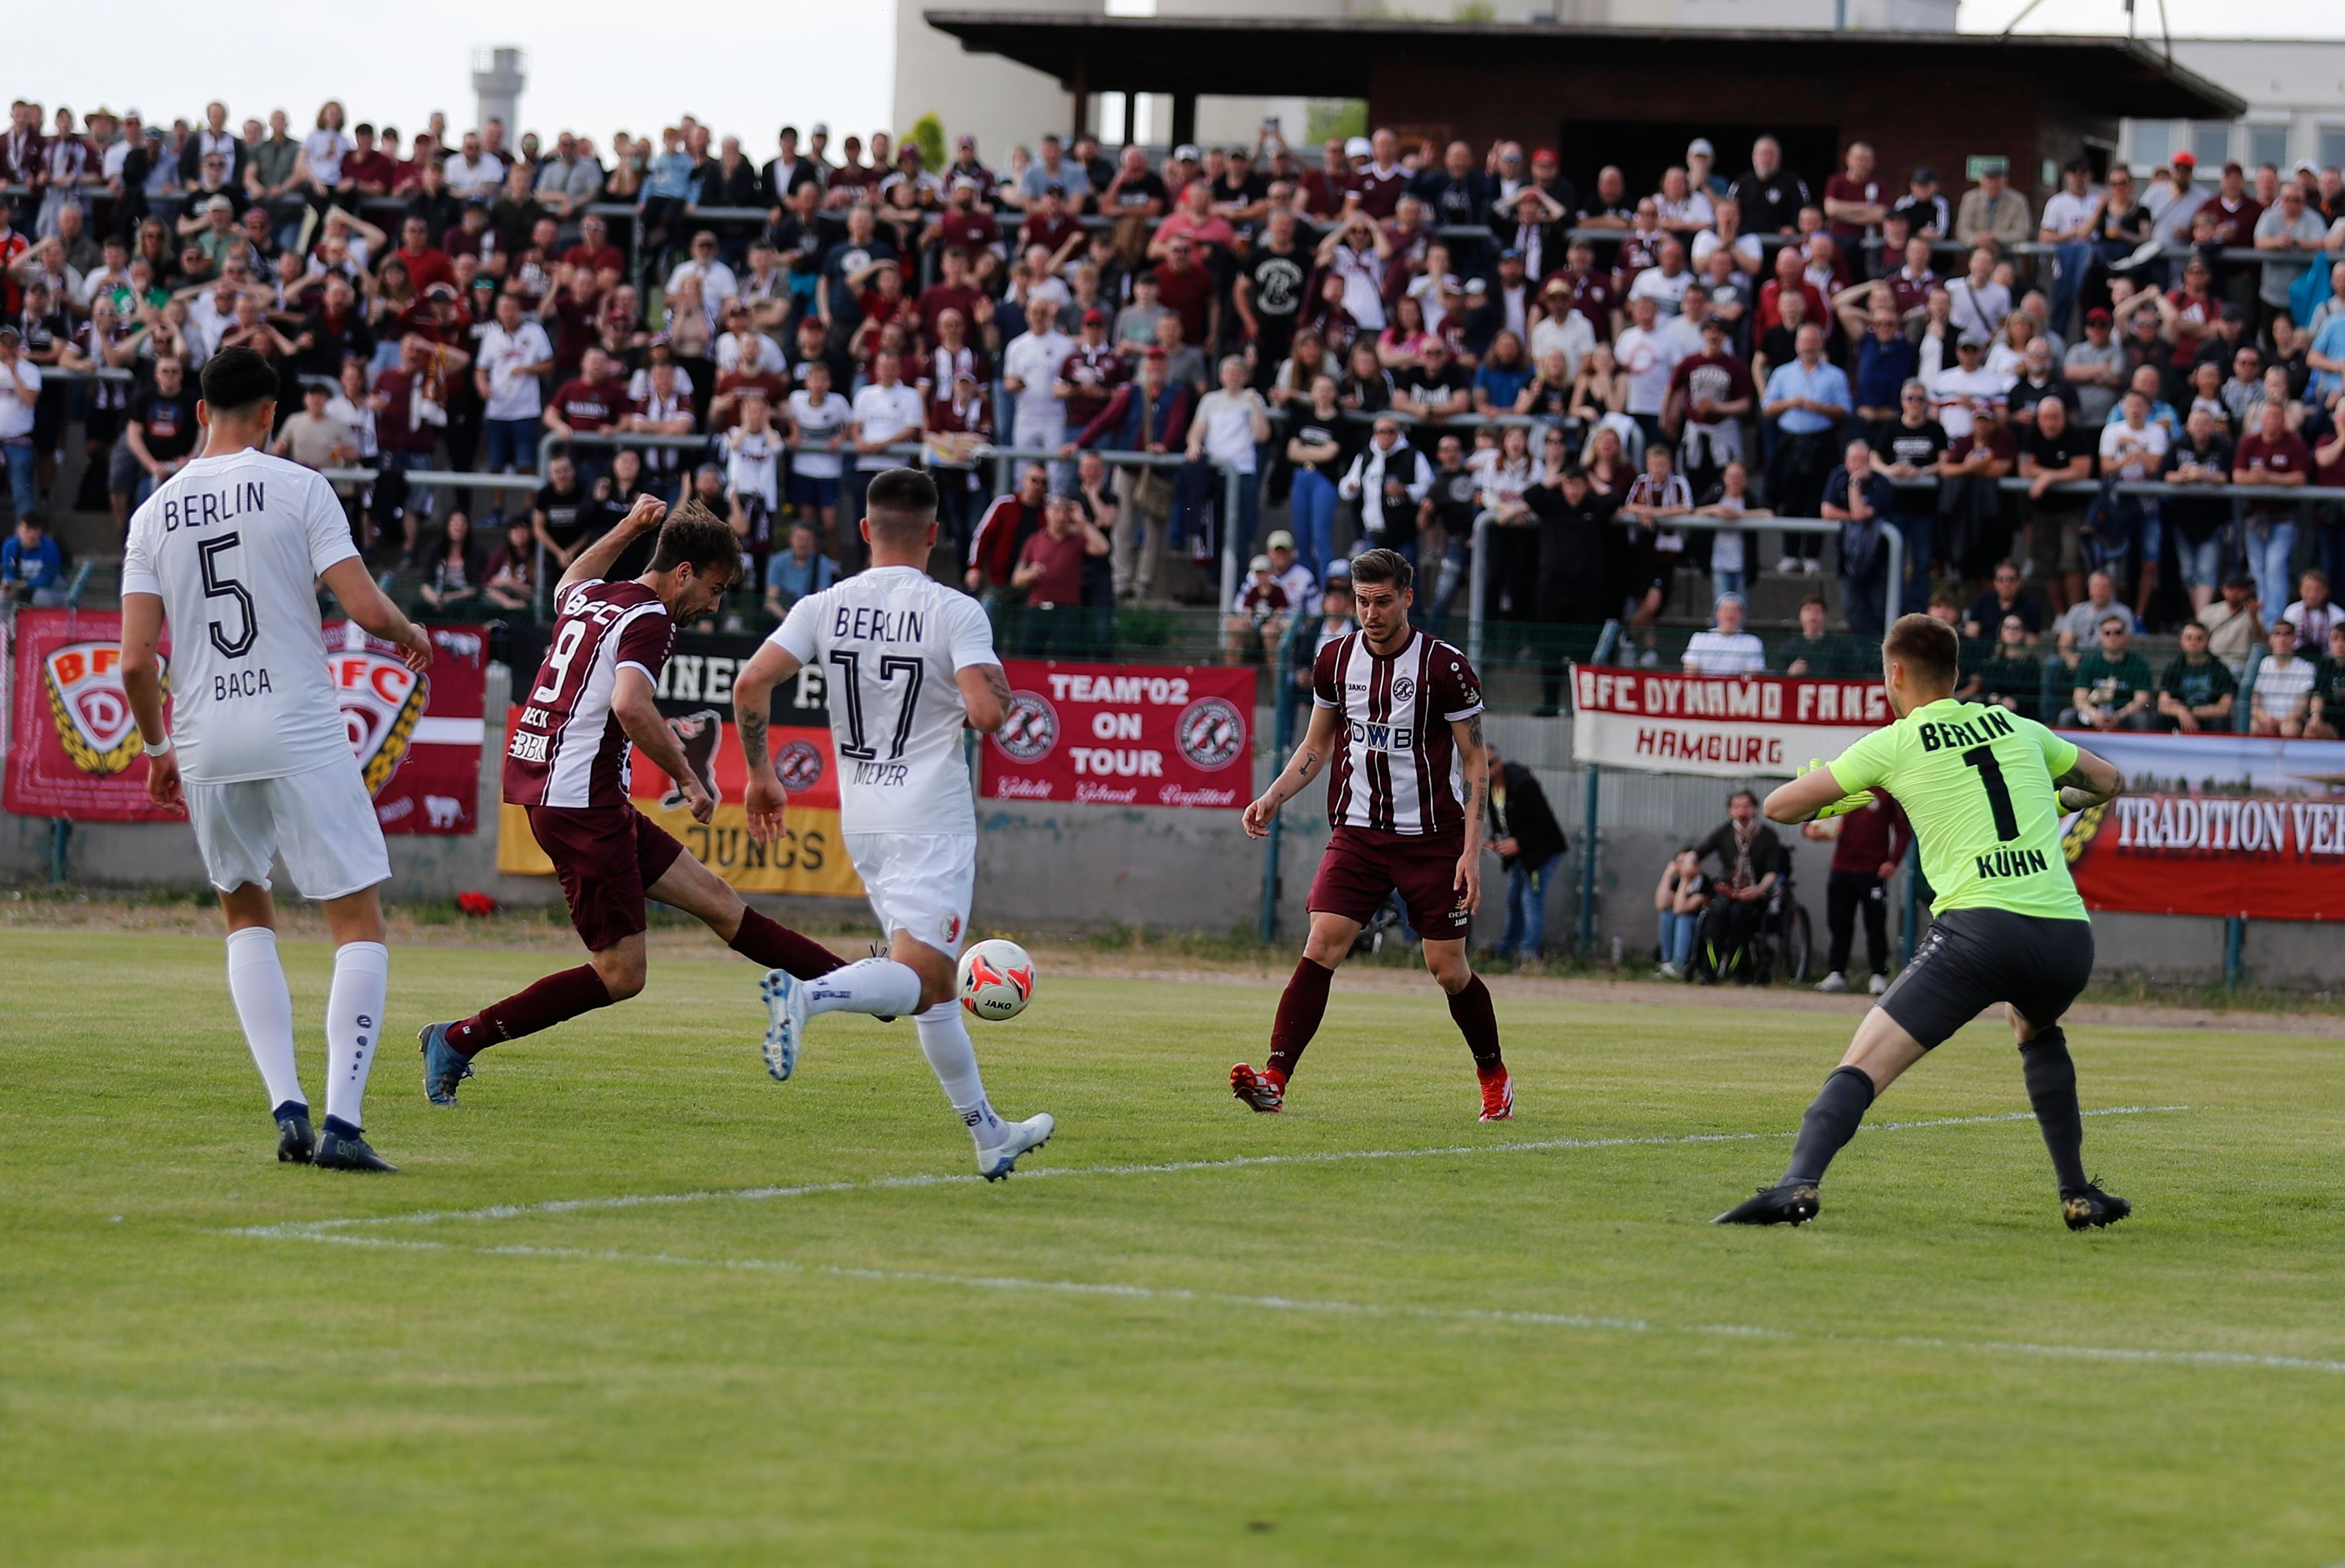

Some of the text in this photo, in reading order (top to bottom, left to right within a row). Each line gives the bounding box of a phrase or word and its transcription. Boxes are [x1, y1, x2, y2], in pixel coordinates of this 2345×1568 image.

[165, 482, 265, 532] BERLIN
[198, 531, 259, 659] 5
[563, 593, 625, 626] BFC
[834, 607, 924, 642] BERLIN
[54, 649, 121, 687] BF
[533, 619, 587, 703] 9
[214, 668, 272, 701] BACA
[329, 659, 408, 704] FC
[1048, 673, 1190, 705] TEAM'02
[1579, 670, 1887, 721] BFC DYNAMO FANS
[520, 706, 550, 728] BECK
[830, 649, 923, 760] 17
[1091, 710, 1143, 741] ON
[1353, 722, 1413, 750] DWB
[1918, 711, 2015, 752] BERLIN
[1068, 746, 1164, 777] TOUR
[1635, 728, 1782, 765] HAMBURG
[853, 761, 909, 786] MEYER
[1961, 744, 2020, 842] 1
[2115, 797, 2286, 853] TRADITION
[1976, 845, 2048, 879] KÜHN
[984, 999, 1012, 1010] JAKO
